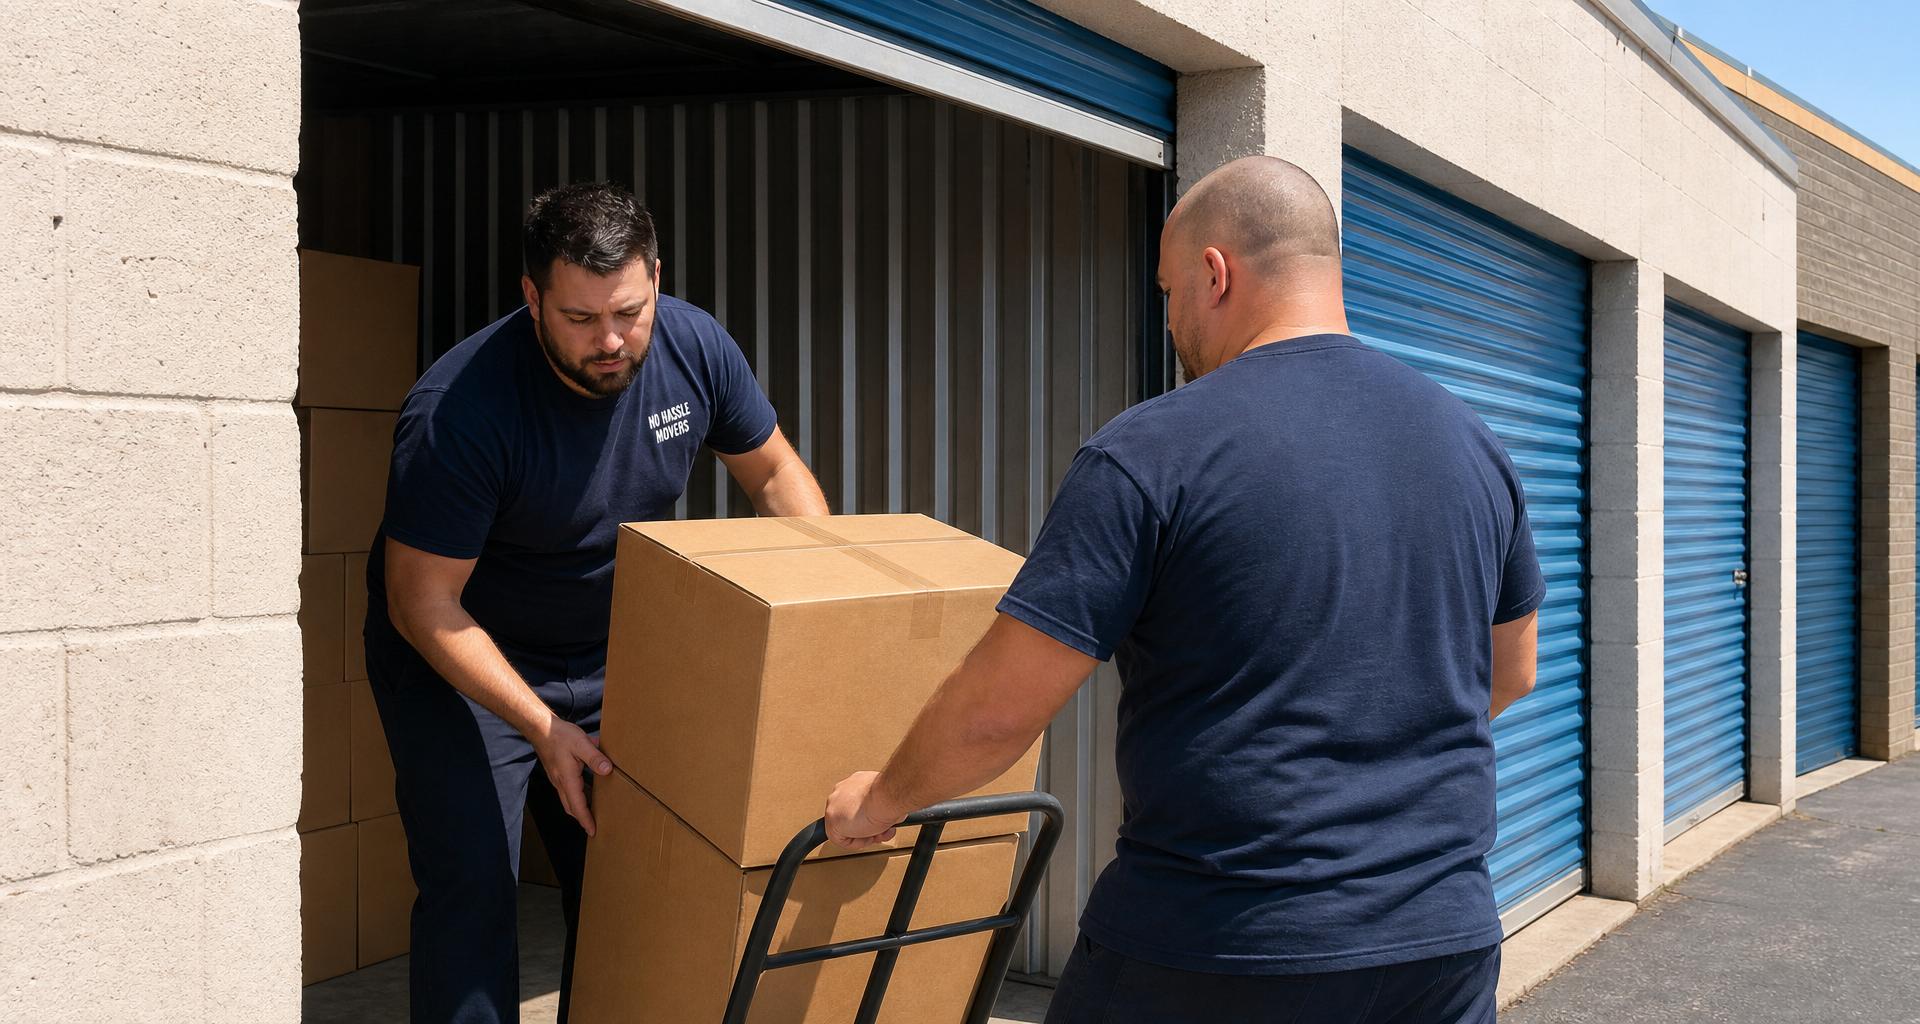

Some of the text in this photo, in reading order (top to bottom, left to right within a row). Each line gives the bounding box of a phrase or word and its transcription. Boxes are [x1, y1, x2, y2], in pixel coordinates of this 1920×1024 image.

[648, 402, 691, 430] NO HASSLE
[656, 419, 690, 444] MOVERS
